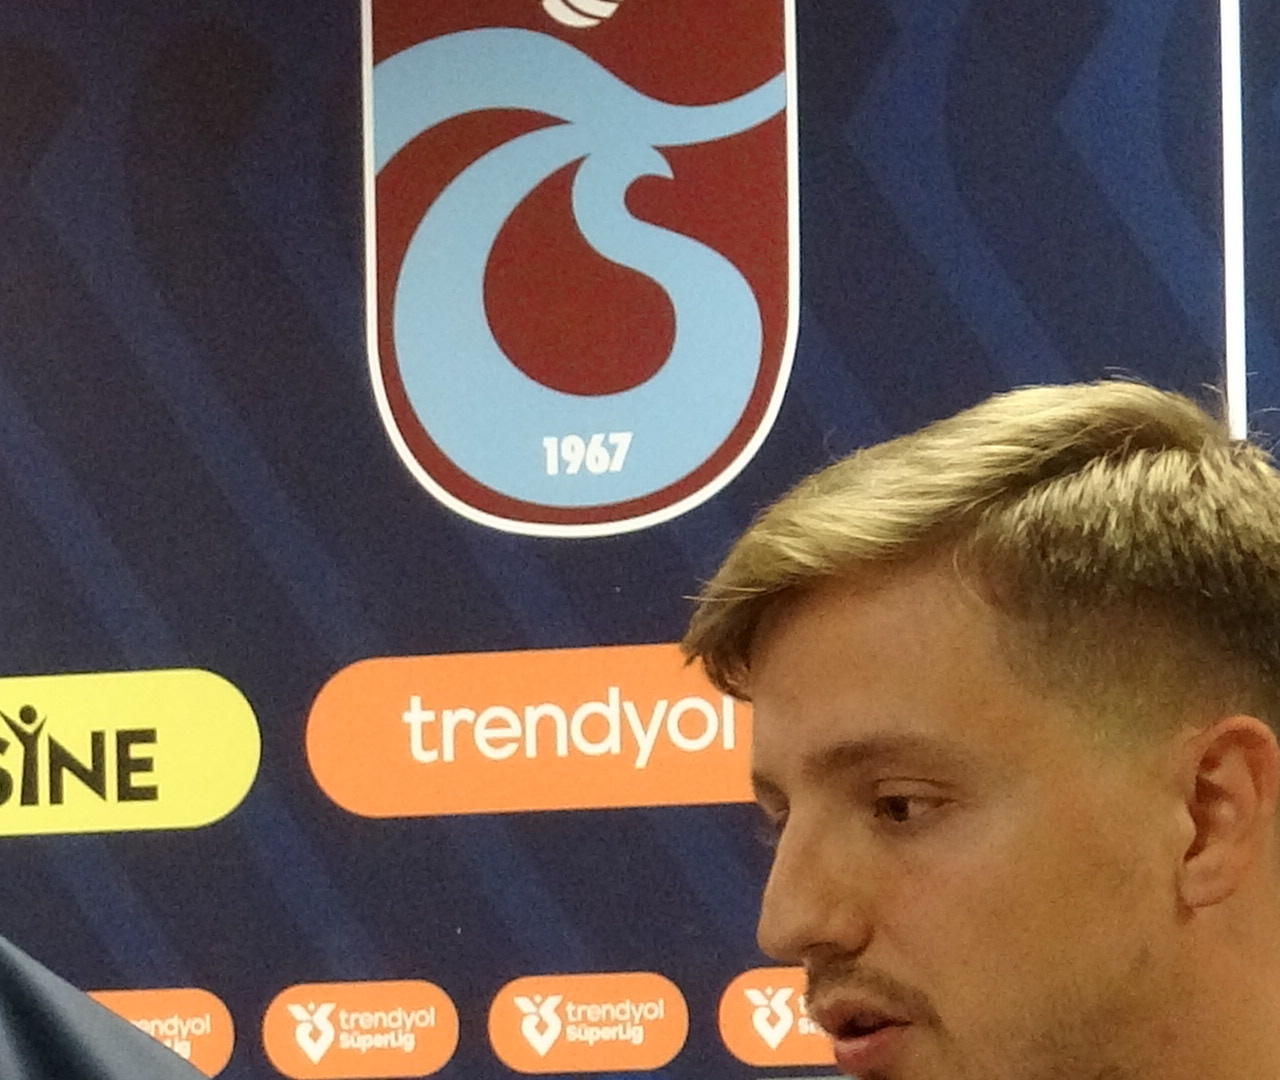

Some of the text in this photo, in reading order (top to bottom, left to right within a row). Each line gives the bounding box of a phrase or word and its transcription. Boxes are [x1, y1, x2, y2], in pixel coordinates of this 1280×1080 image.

[542, 432, 634, 476] 1967
[401, 685, 736, 769] trendyol
[339, 1006, 436, 1032] trendyol
[565, 997, 665, 1024] trendyol
